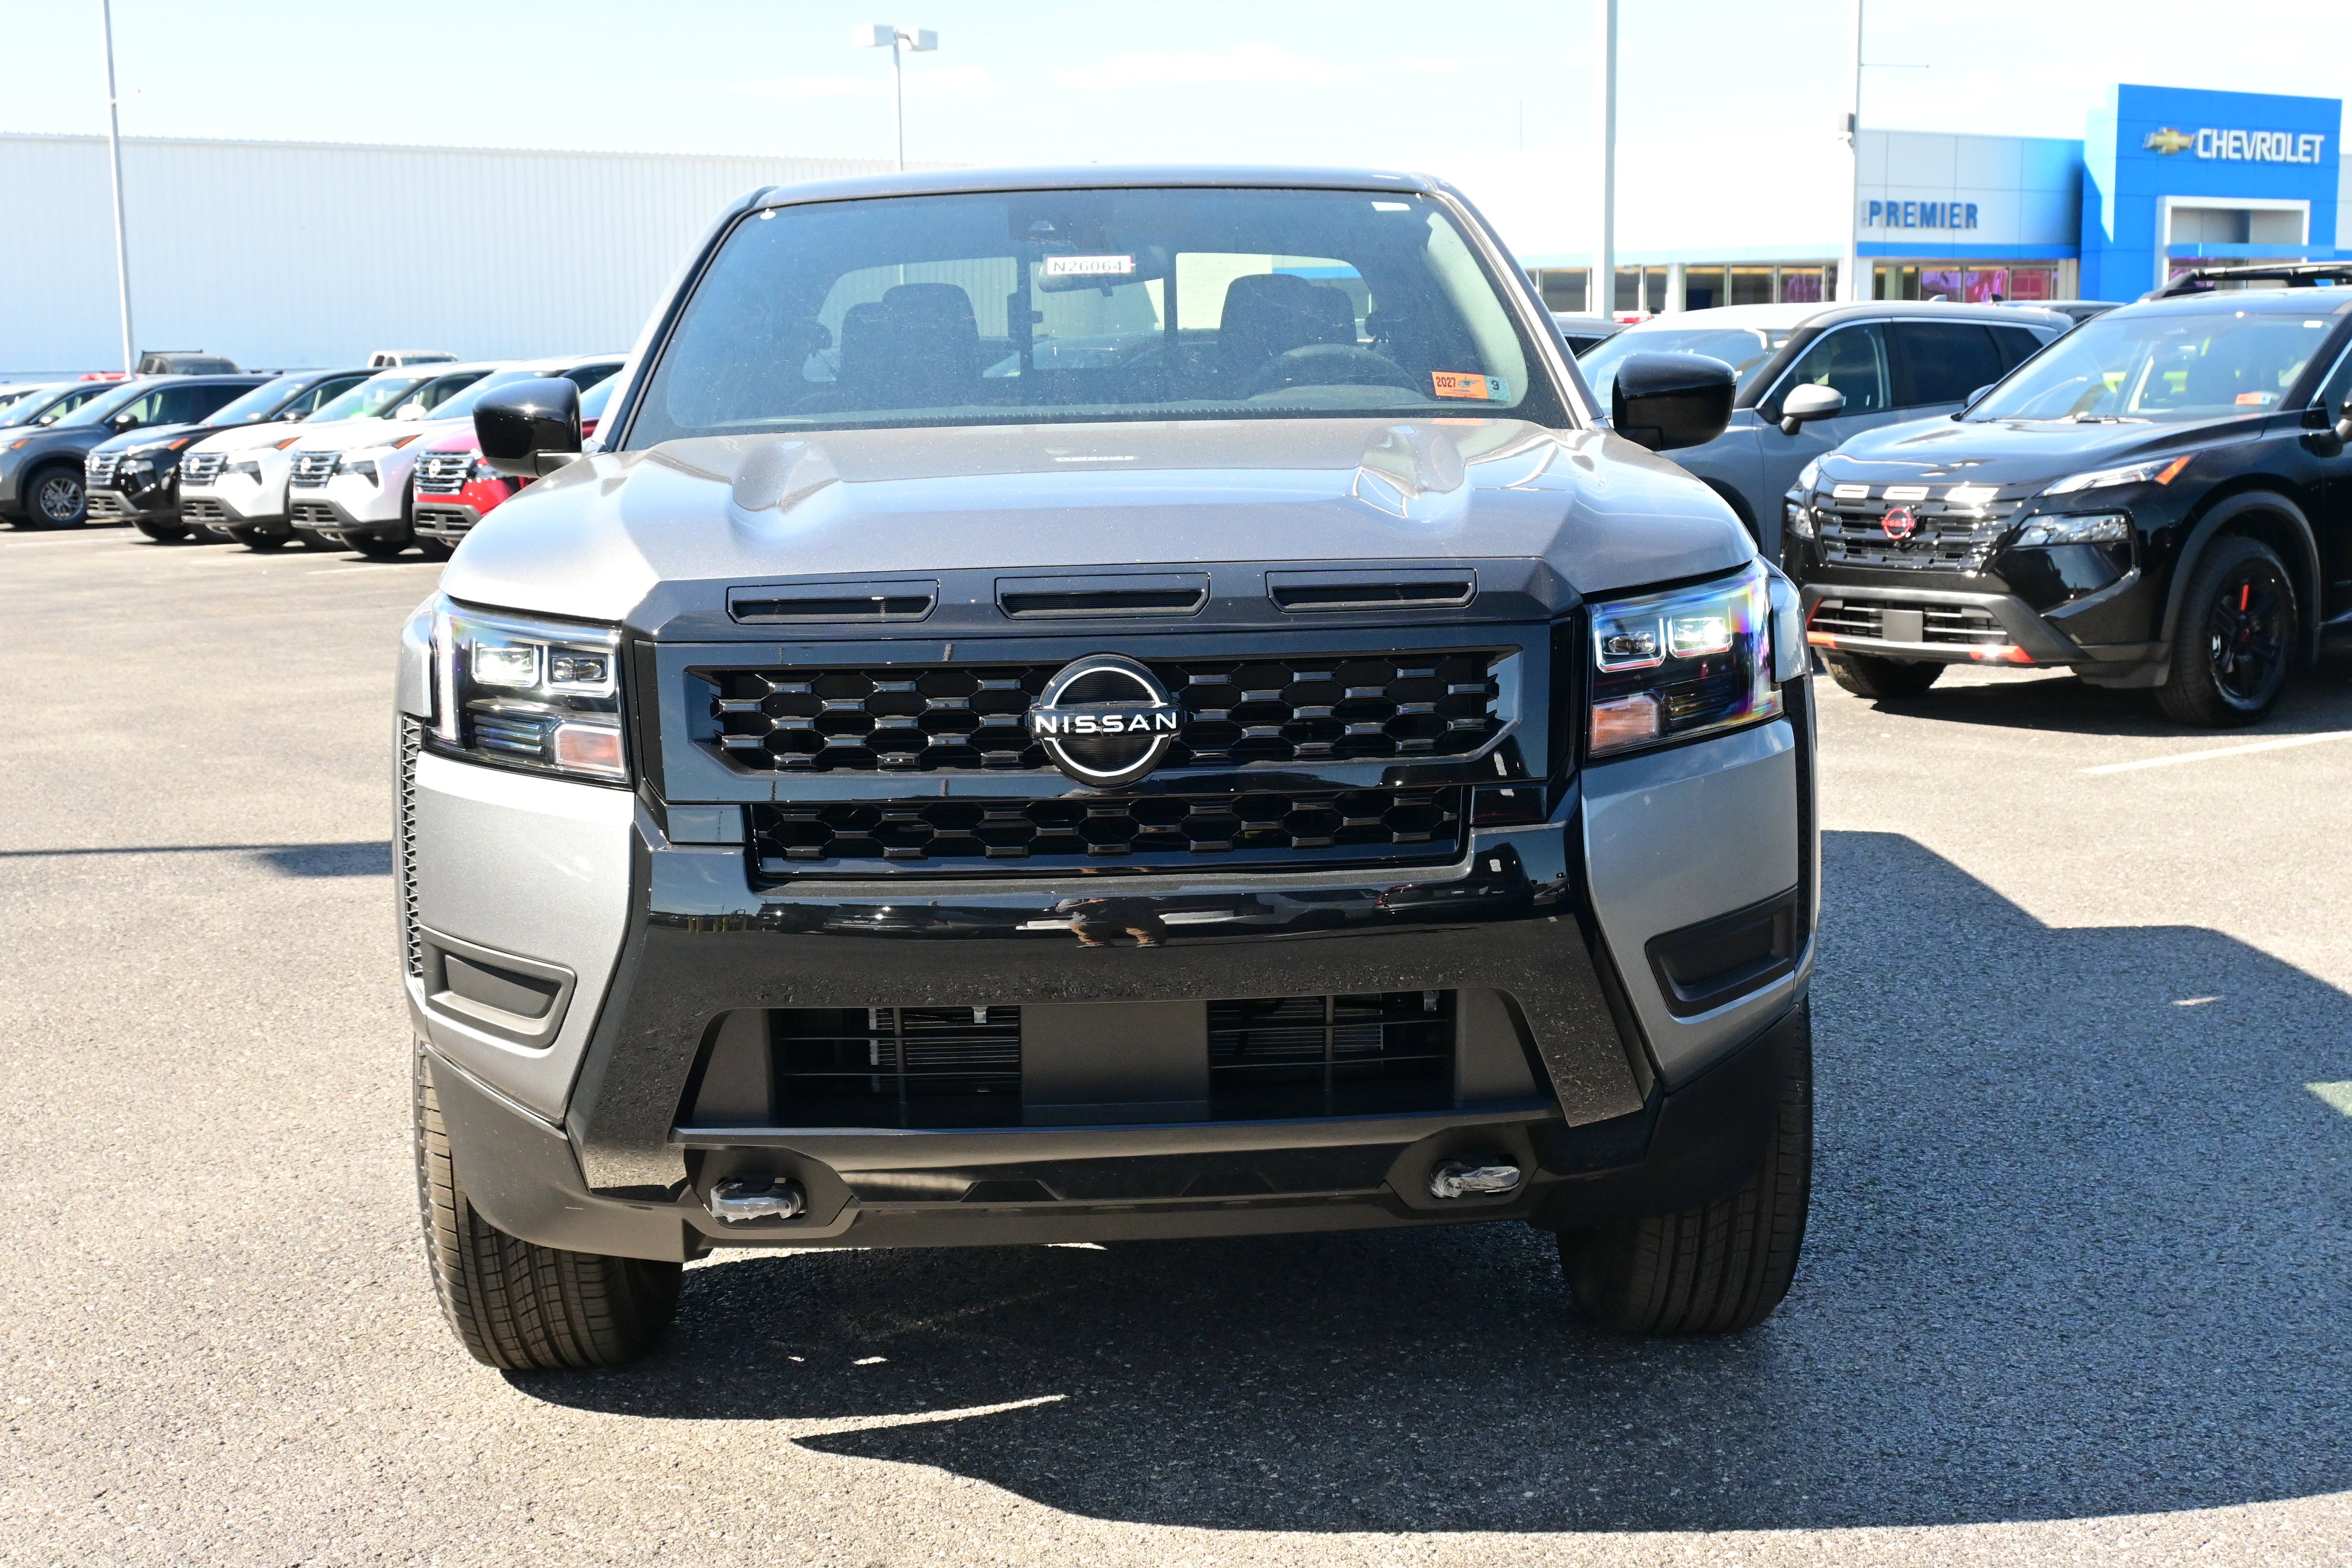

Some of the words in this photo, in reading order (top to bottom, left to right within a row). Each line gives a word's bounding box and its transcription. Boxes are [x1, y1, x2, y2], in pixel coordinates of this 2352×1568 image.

[2197, 128, 2325, 163] CHEVROLET
[1869, 200, 1979, 229] PREMIER
[1054, 260, 1122, 272] N26064
[1436, 376, 1456, 387] 2027
[1035, 712, 1177, 733] NISSAN
